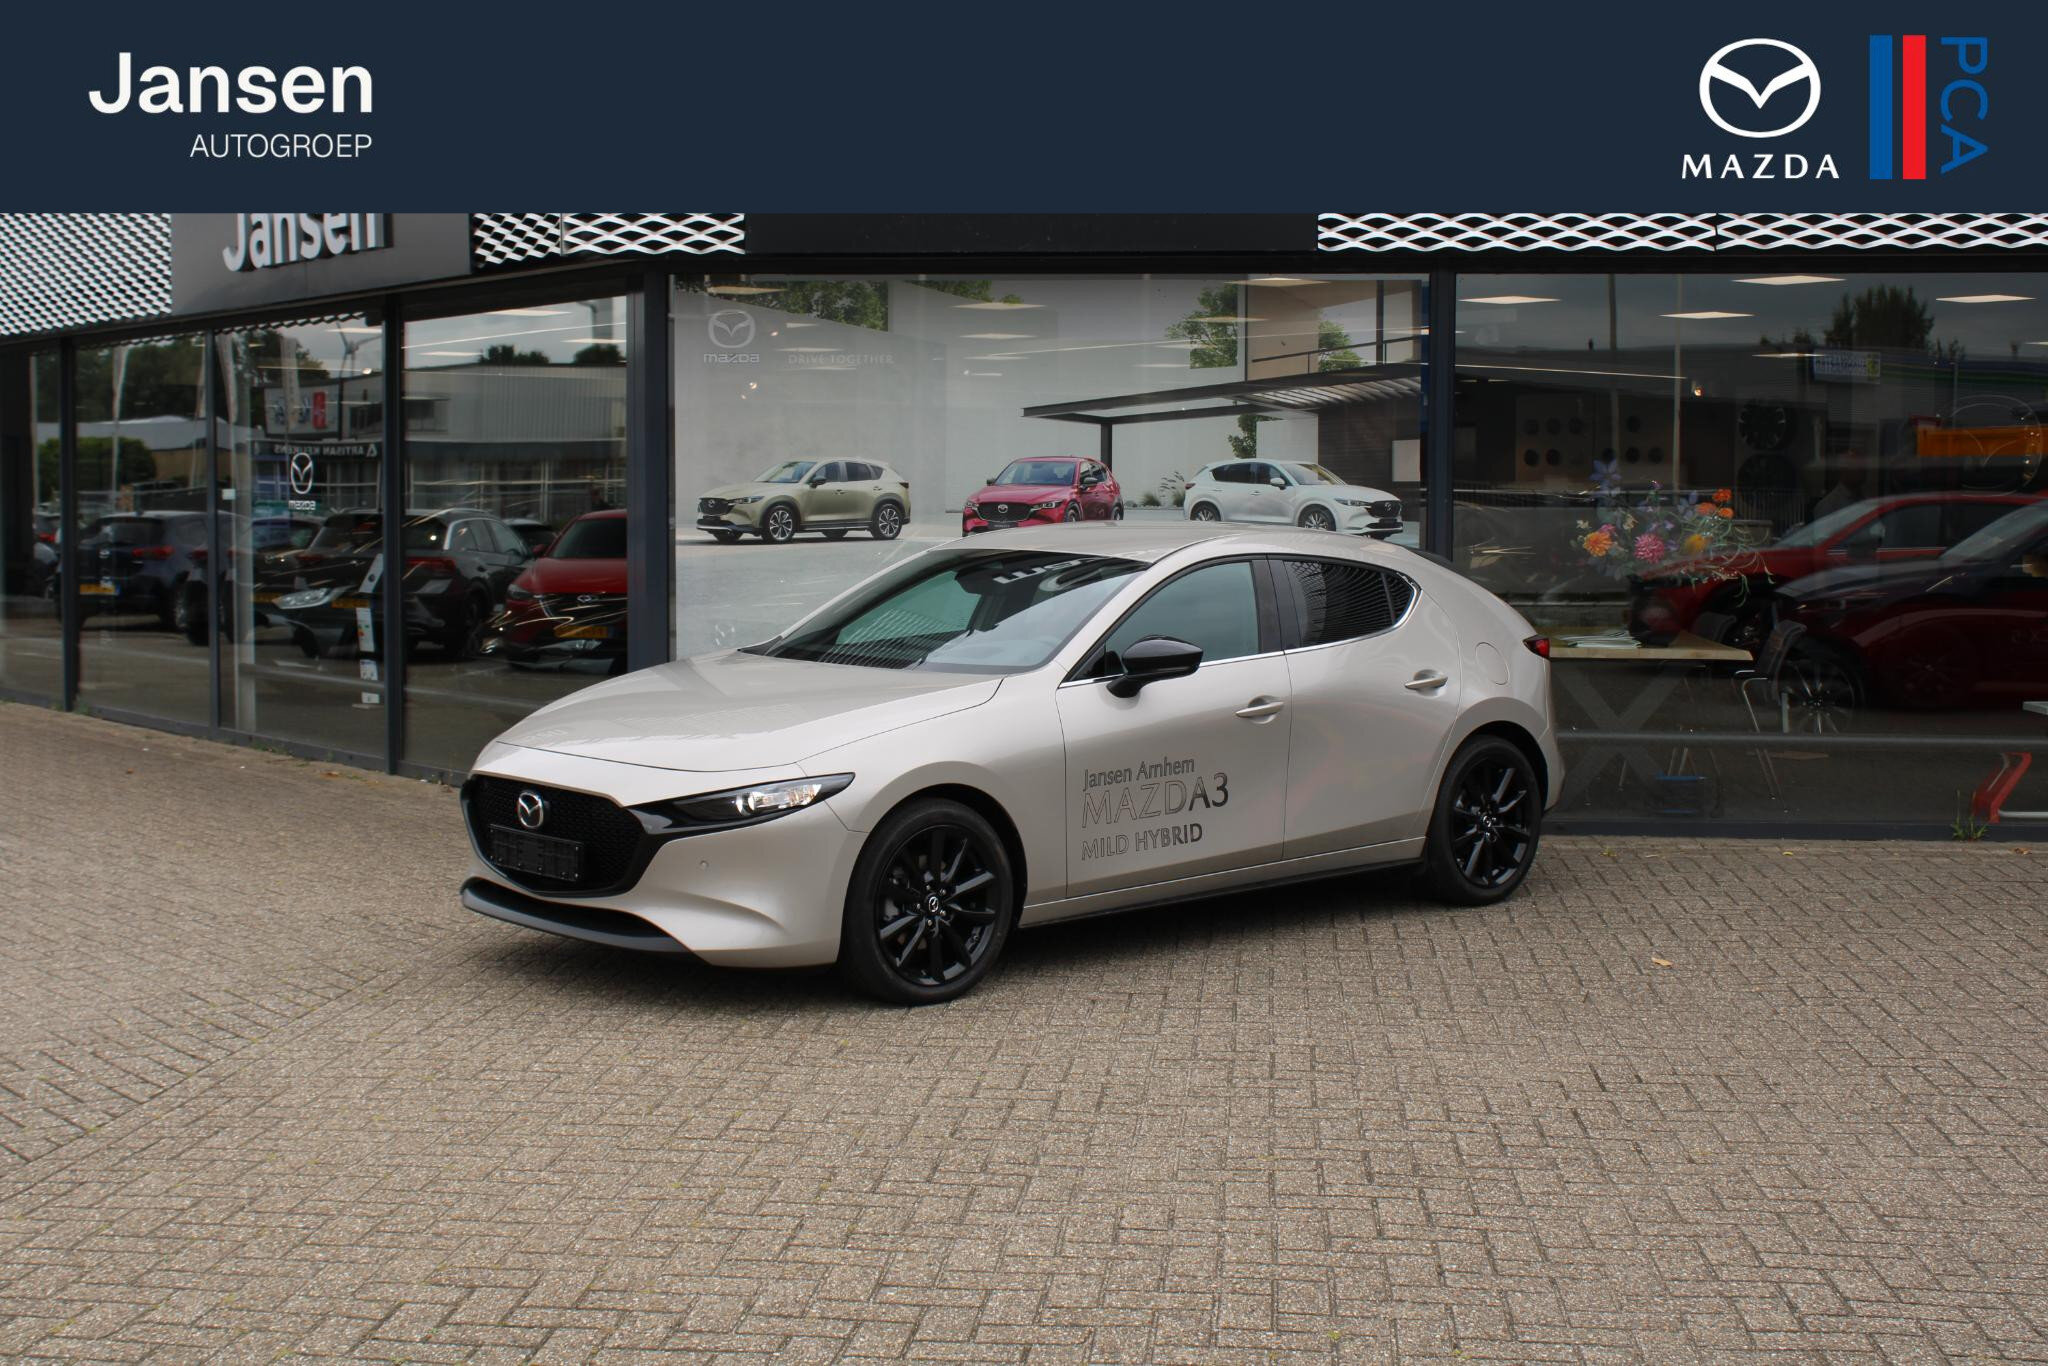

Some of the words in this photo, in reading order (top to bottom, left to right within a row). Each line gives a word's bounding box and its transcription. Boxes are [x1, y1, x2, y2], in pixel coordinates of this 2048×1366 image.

[788, 354, 825, 365] DRIVE
[830, 354, 895, 365] TOGETHER
[1083, 767, 1132, 791] Jansen
[1136, 756, 1195, 781] Arnhem
[1082, 772, 1229, 829] MAZDA3
[1082, 834, 1129, 861] MILD
[1135, 823, 1203, 852] HYBRID
